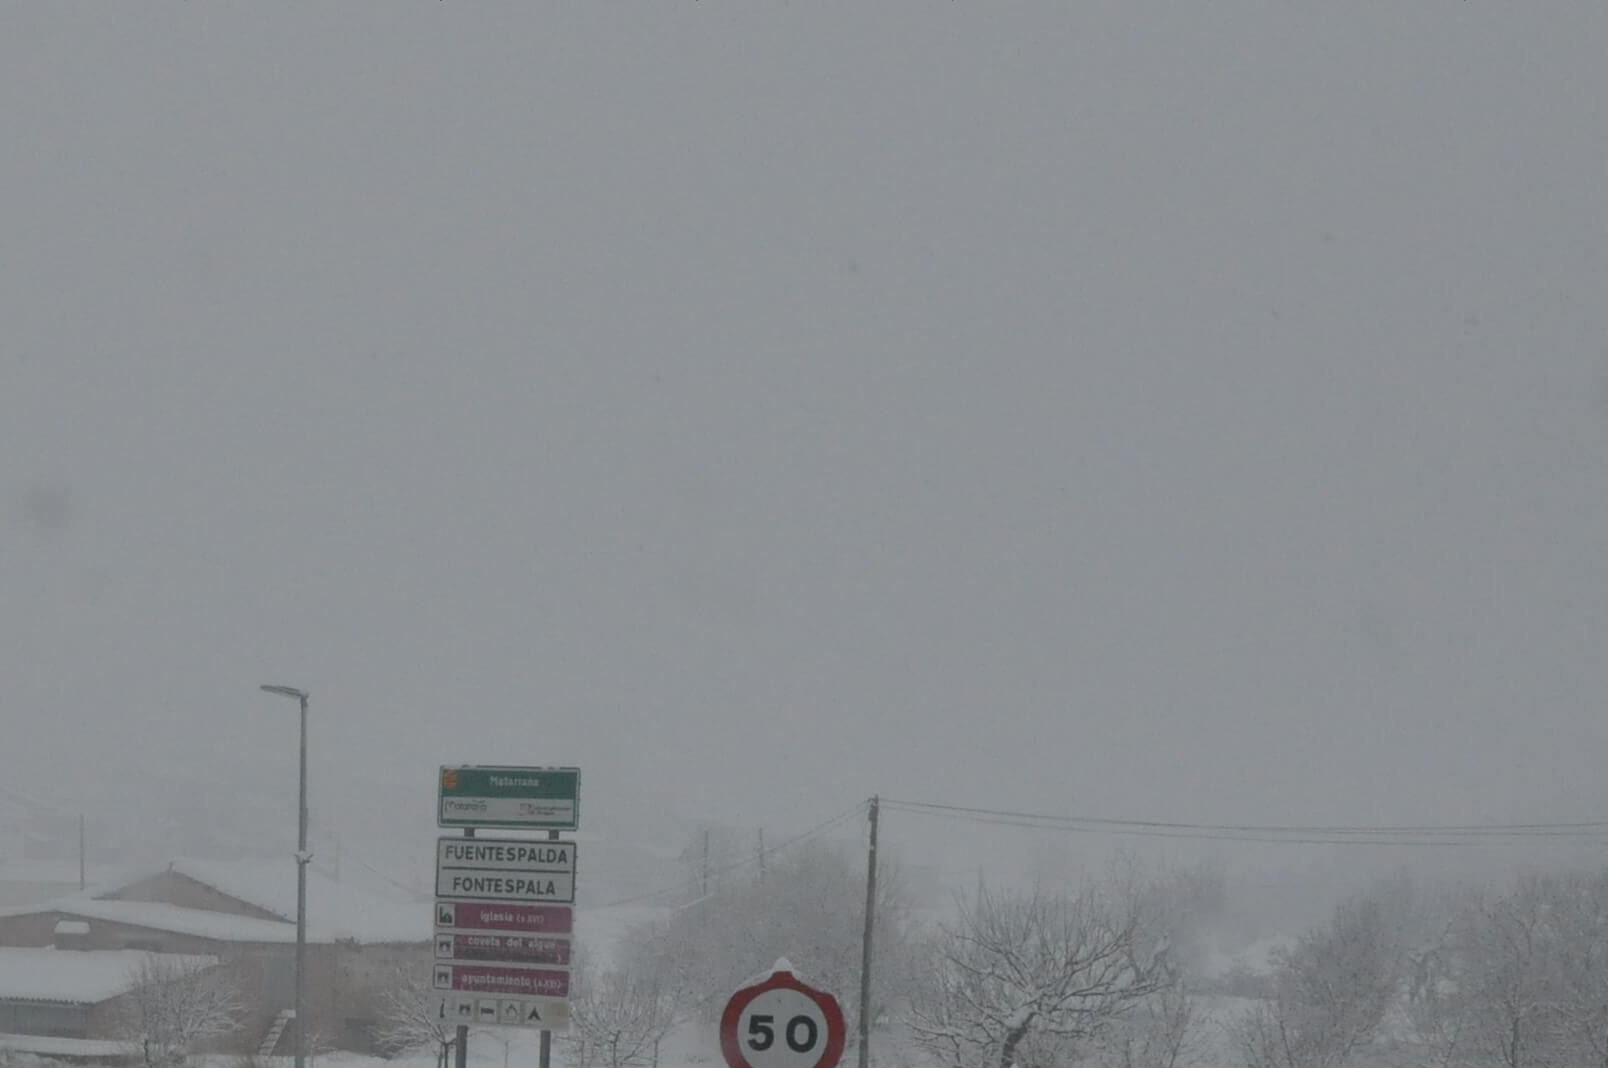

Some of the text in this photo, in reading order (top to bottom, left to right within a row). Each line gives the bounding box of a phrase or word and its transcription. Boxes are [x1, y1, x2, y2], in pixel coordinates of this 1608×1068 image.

[445, 845, 568, 863] FUENTESPALDA
[453, 877, 556, 895] FONTESPALA
[480, 911, 513, 923] iglesia
[462, 974, 530, 987] ayuntamiento
[747, 1015, 818, 1053] 50
